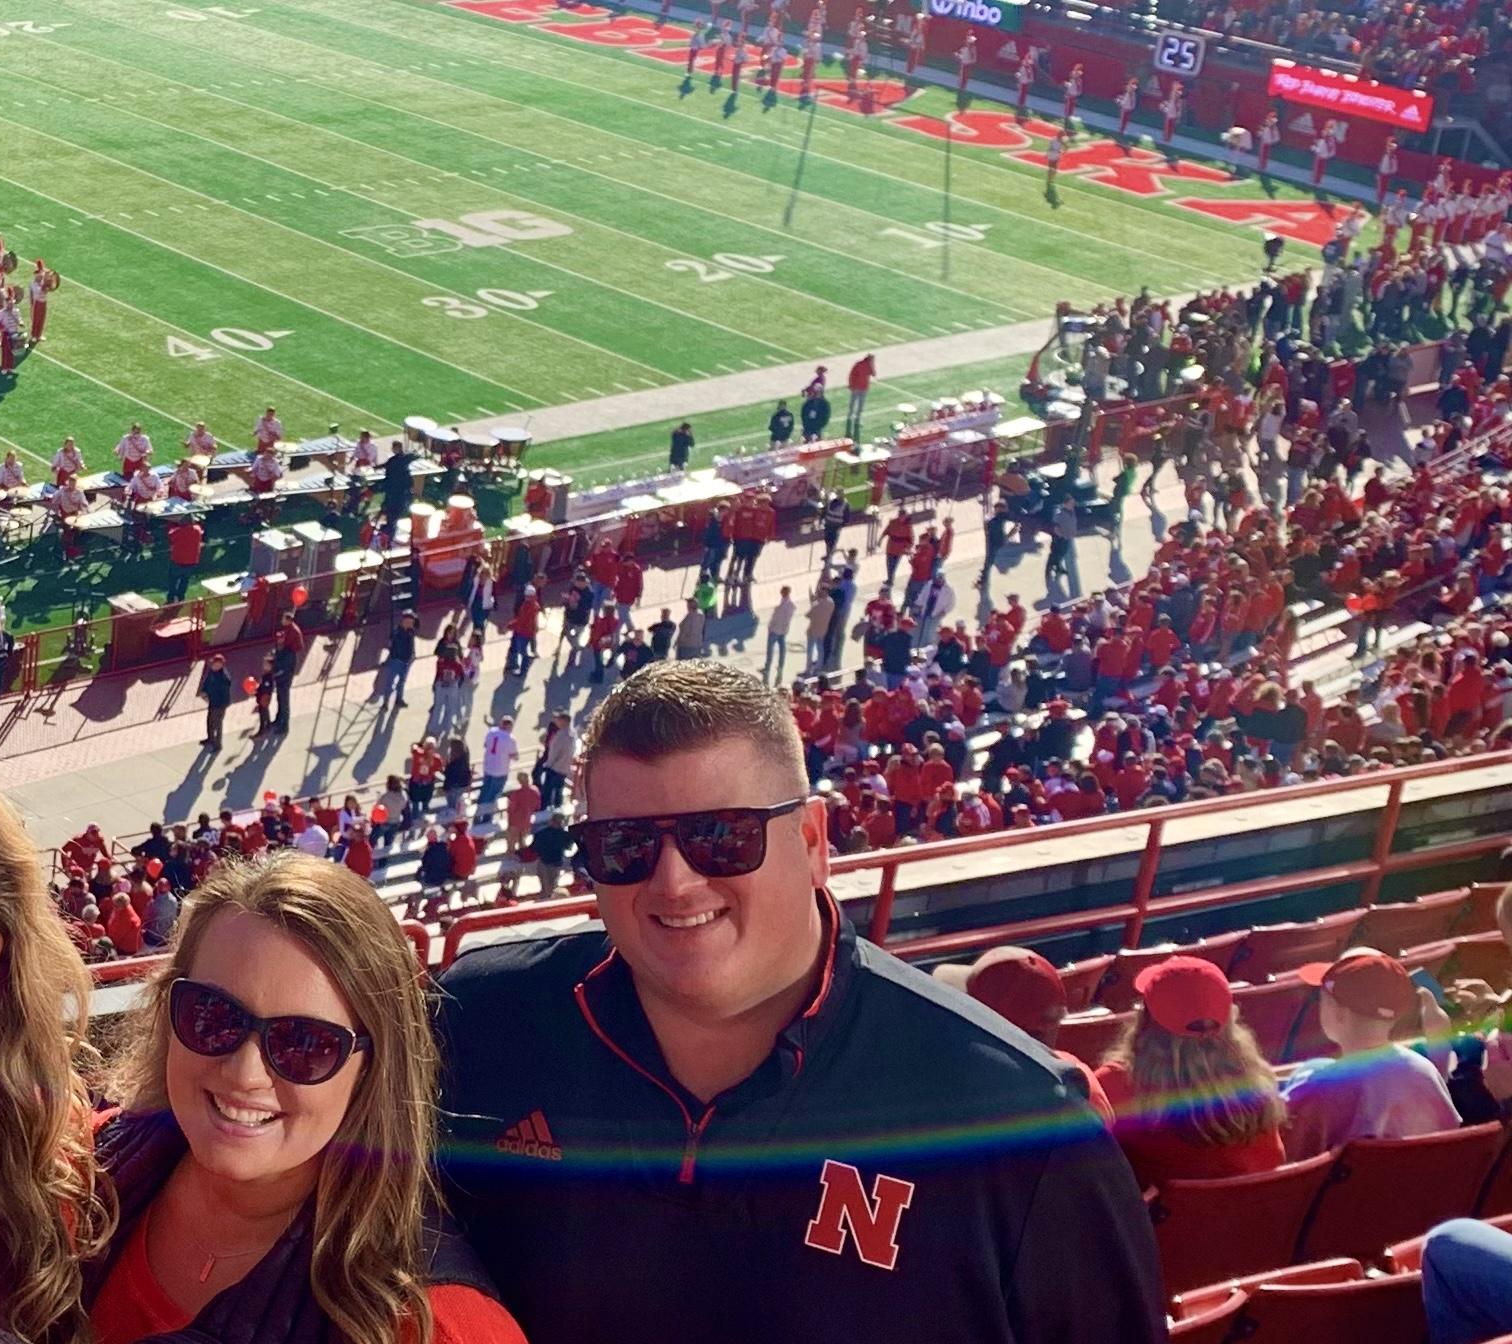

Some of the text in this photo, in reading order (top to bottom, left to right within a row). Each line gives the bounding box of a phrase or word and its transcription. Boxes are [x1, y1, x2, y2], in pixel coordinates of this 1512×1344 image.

[1161, 37, 1196, 70] 25
[664, 250, 777, 284] 20
[421, 287, 538, 319] 30
[165, 326, 276, 363] 40
[494, 1136, 563, 1162] adidas
[804, 1158, 915, 1271] N
